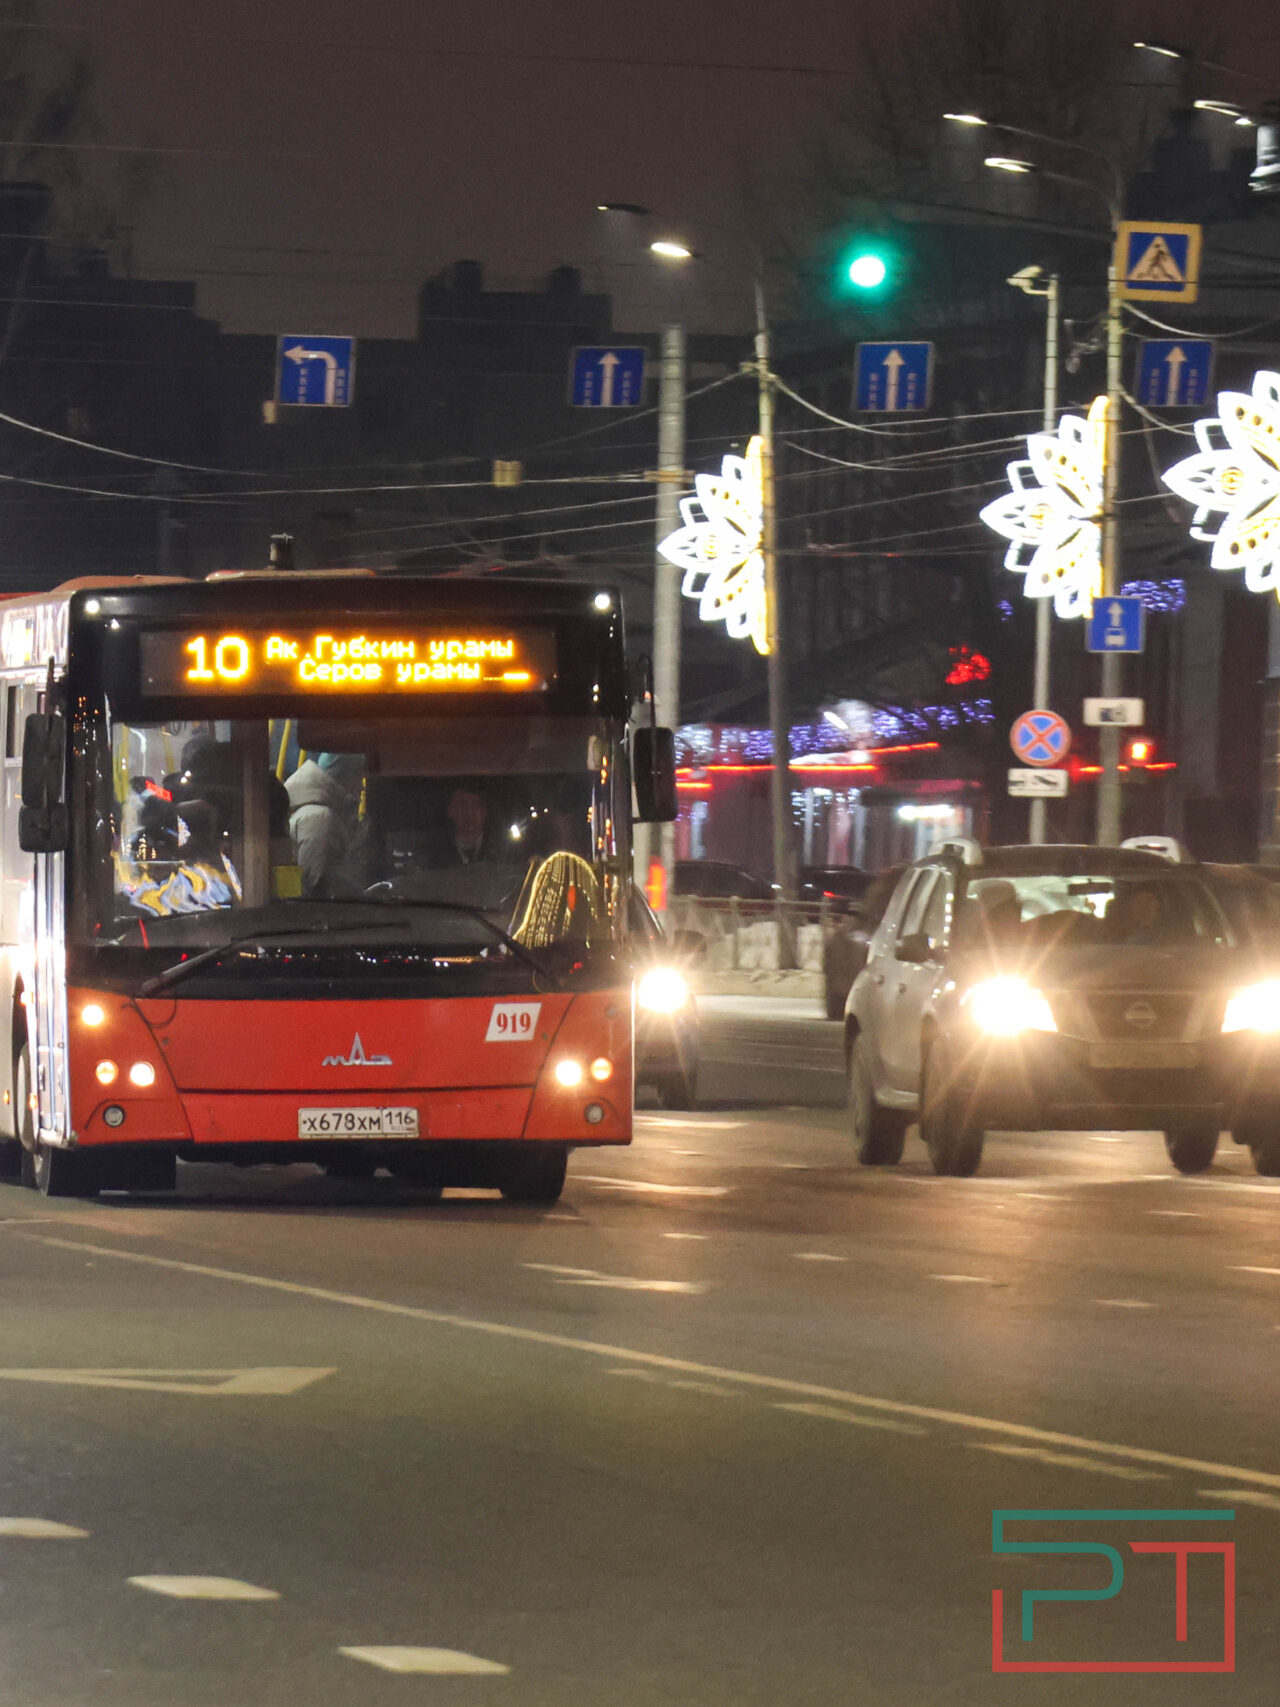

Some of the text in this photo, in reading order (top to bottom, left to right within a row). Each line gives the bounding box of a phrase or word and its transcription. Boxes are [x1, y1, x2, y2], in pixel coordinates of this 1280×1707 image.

[187, 636, 249, 679] 10
[429, 639, 514, 661] урамы
[299, 658, 480, 683] Серов урамы
[496, 1012, 532, 1034] 919
